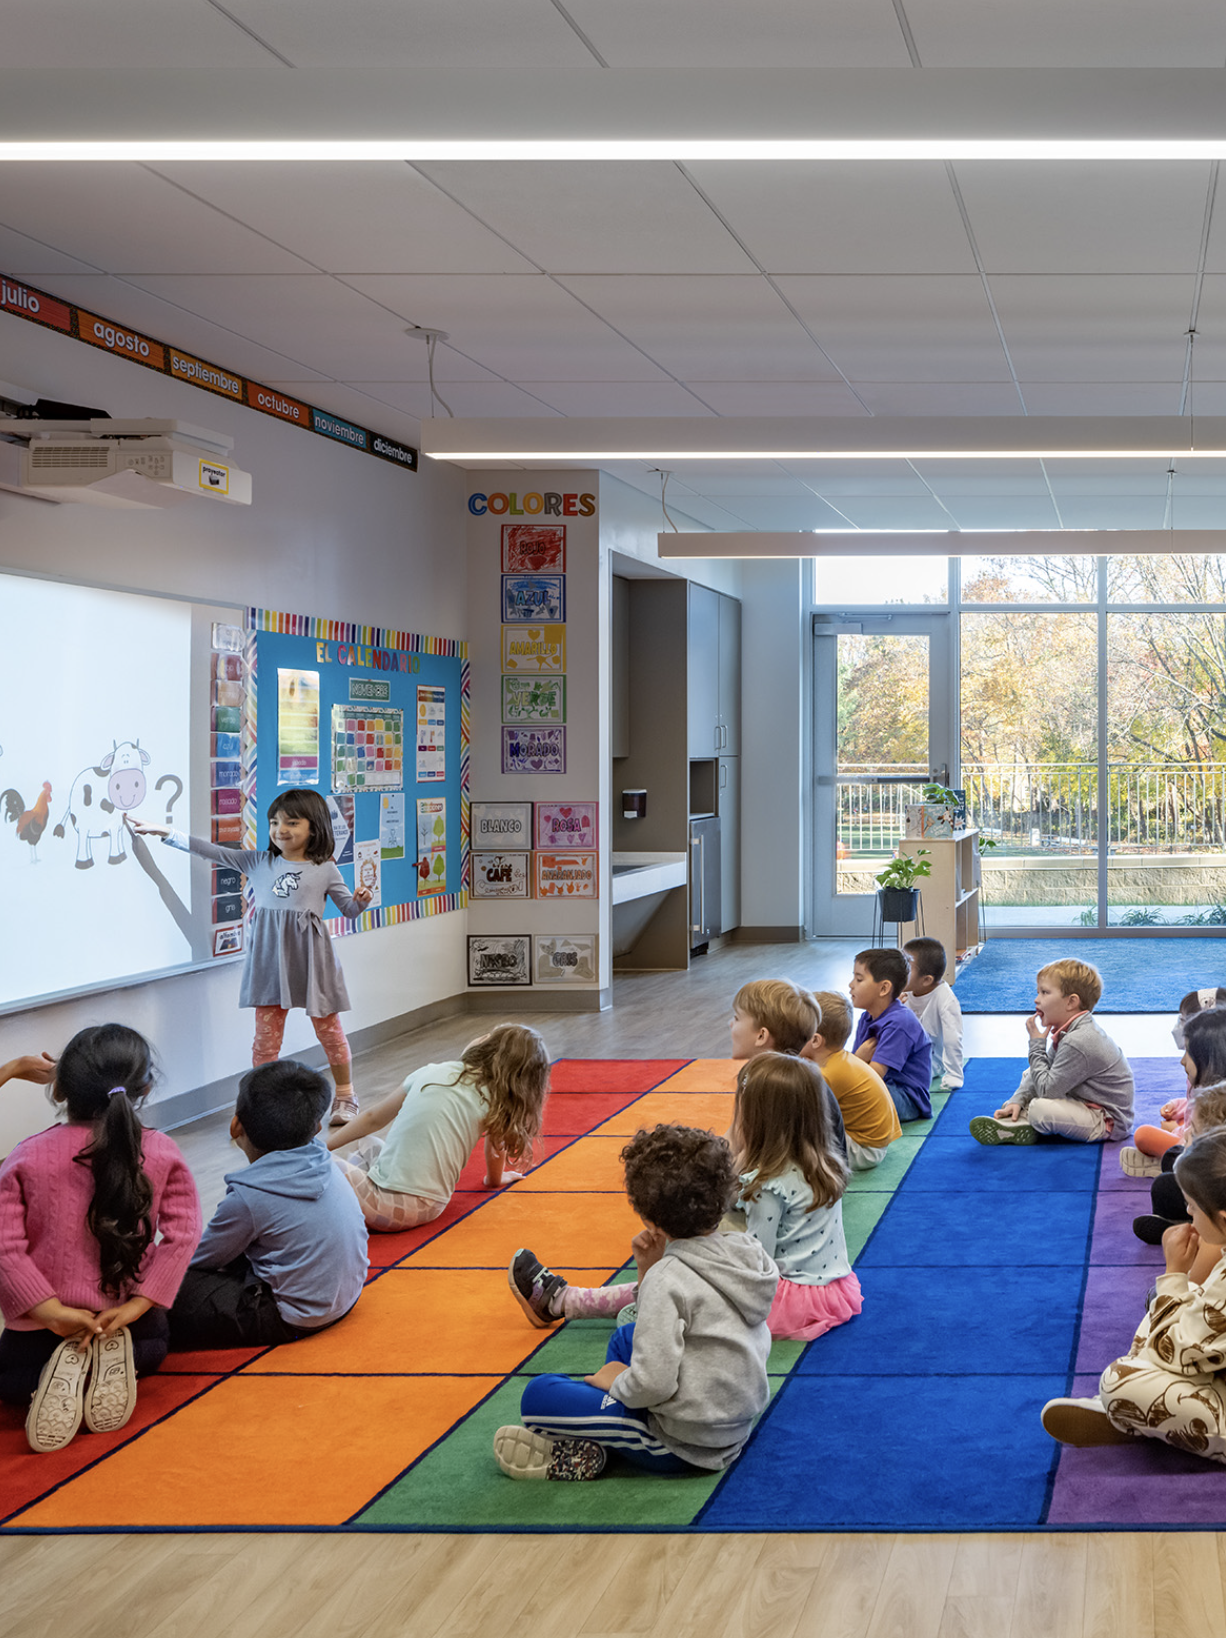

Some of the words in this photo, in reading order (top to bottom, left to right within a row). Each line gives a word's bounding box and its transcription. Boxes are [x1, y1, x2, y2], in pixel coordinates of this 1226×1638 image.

[1, 280, 40, 313] julio
[93, 322, 150, 357] agosto
[172, 355, 239, 394] septiembre
[257, 393, 300, 419] octubre
[314, 415, 364, 445] noviembre
[373, 438, 413, 464] diciembre
[468, 492, 596, 517] COLORES
[519, 540, 546, 555] ROJO
[515, 590, 550, 607] AZUL
[316, 642, 332, 663] EL
[338, 645, 420, 674] CALENDARIO
[509, 641, 558, 655] AMARILLO
[509, 742, 560, 757] MORADO
[480, 818, 522, 834] BLANCO
[552, 817, 582, 833] ROSA
[221, 876, 237, 885] negro
[541, 868, 592, 881] ANARANJADO
